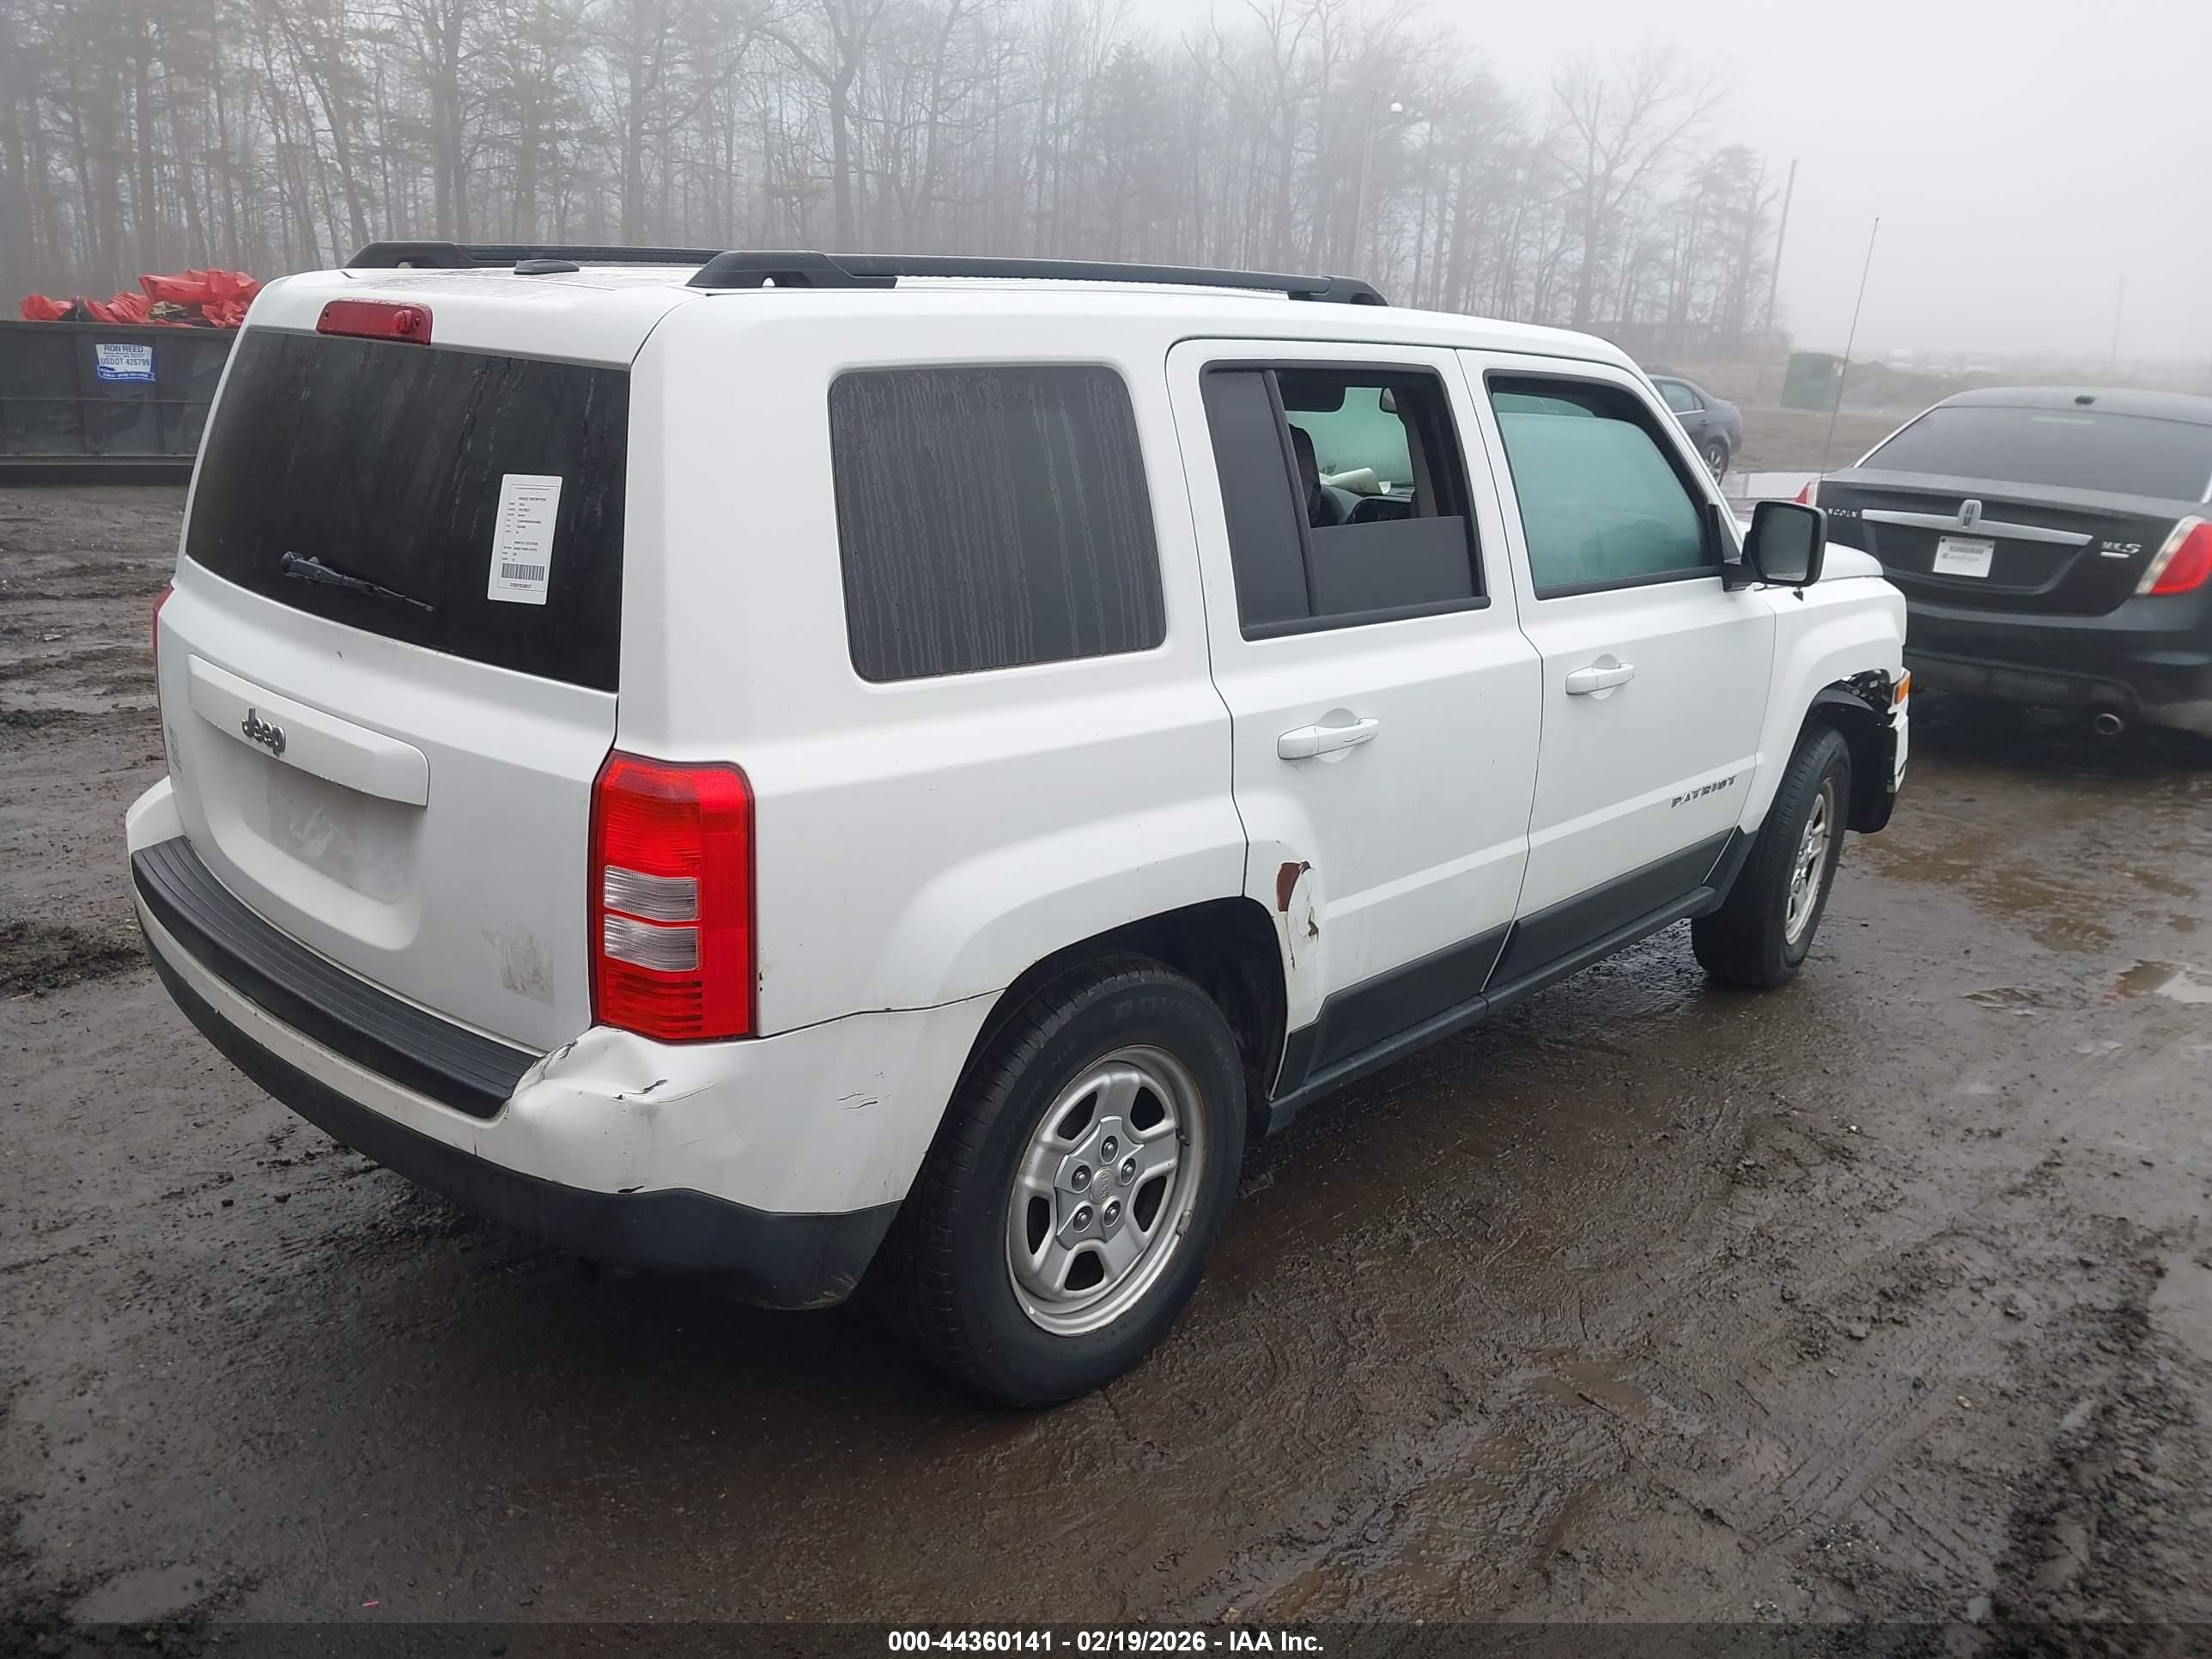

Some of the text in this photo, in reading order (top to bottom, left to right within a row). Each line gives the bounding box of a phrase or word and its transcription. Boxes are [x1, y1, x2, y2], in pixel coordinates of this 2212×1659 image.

[2101, 541, 2143, 555] MKS
[241, 707, 287, 757] Jeep
[1670, 775, 1738, 808] PATRIOT
